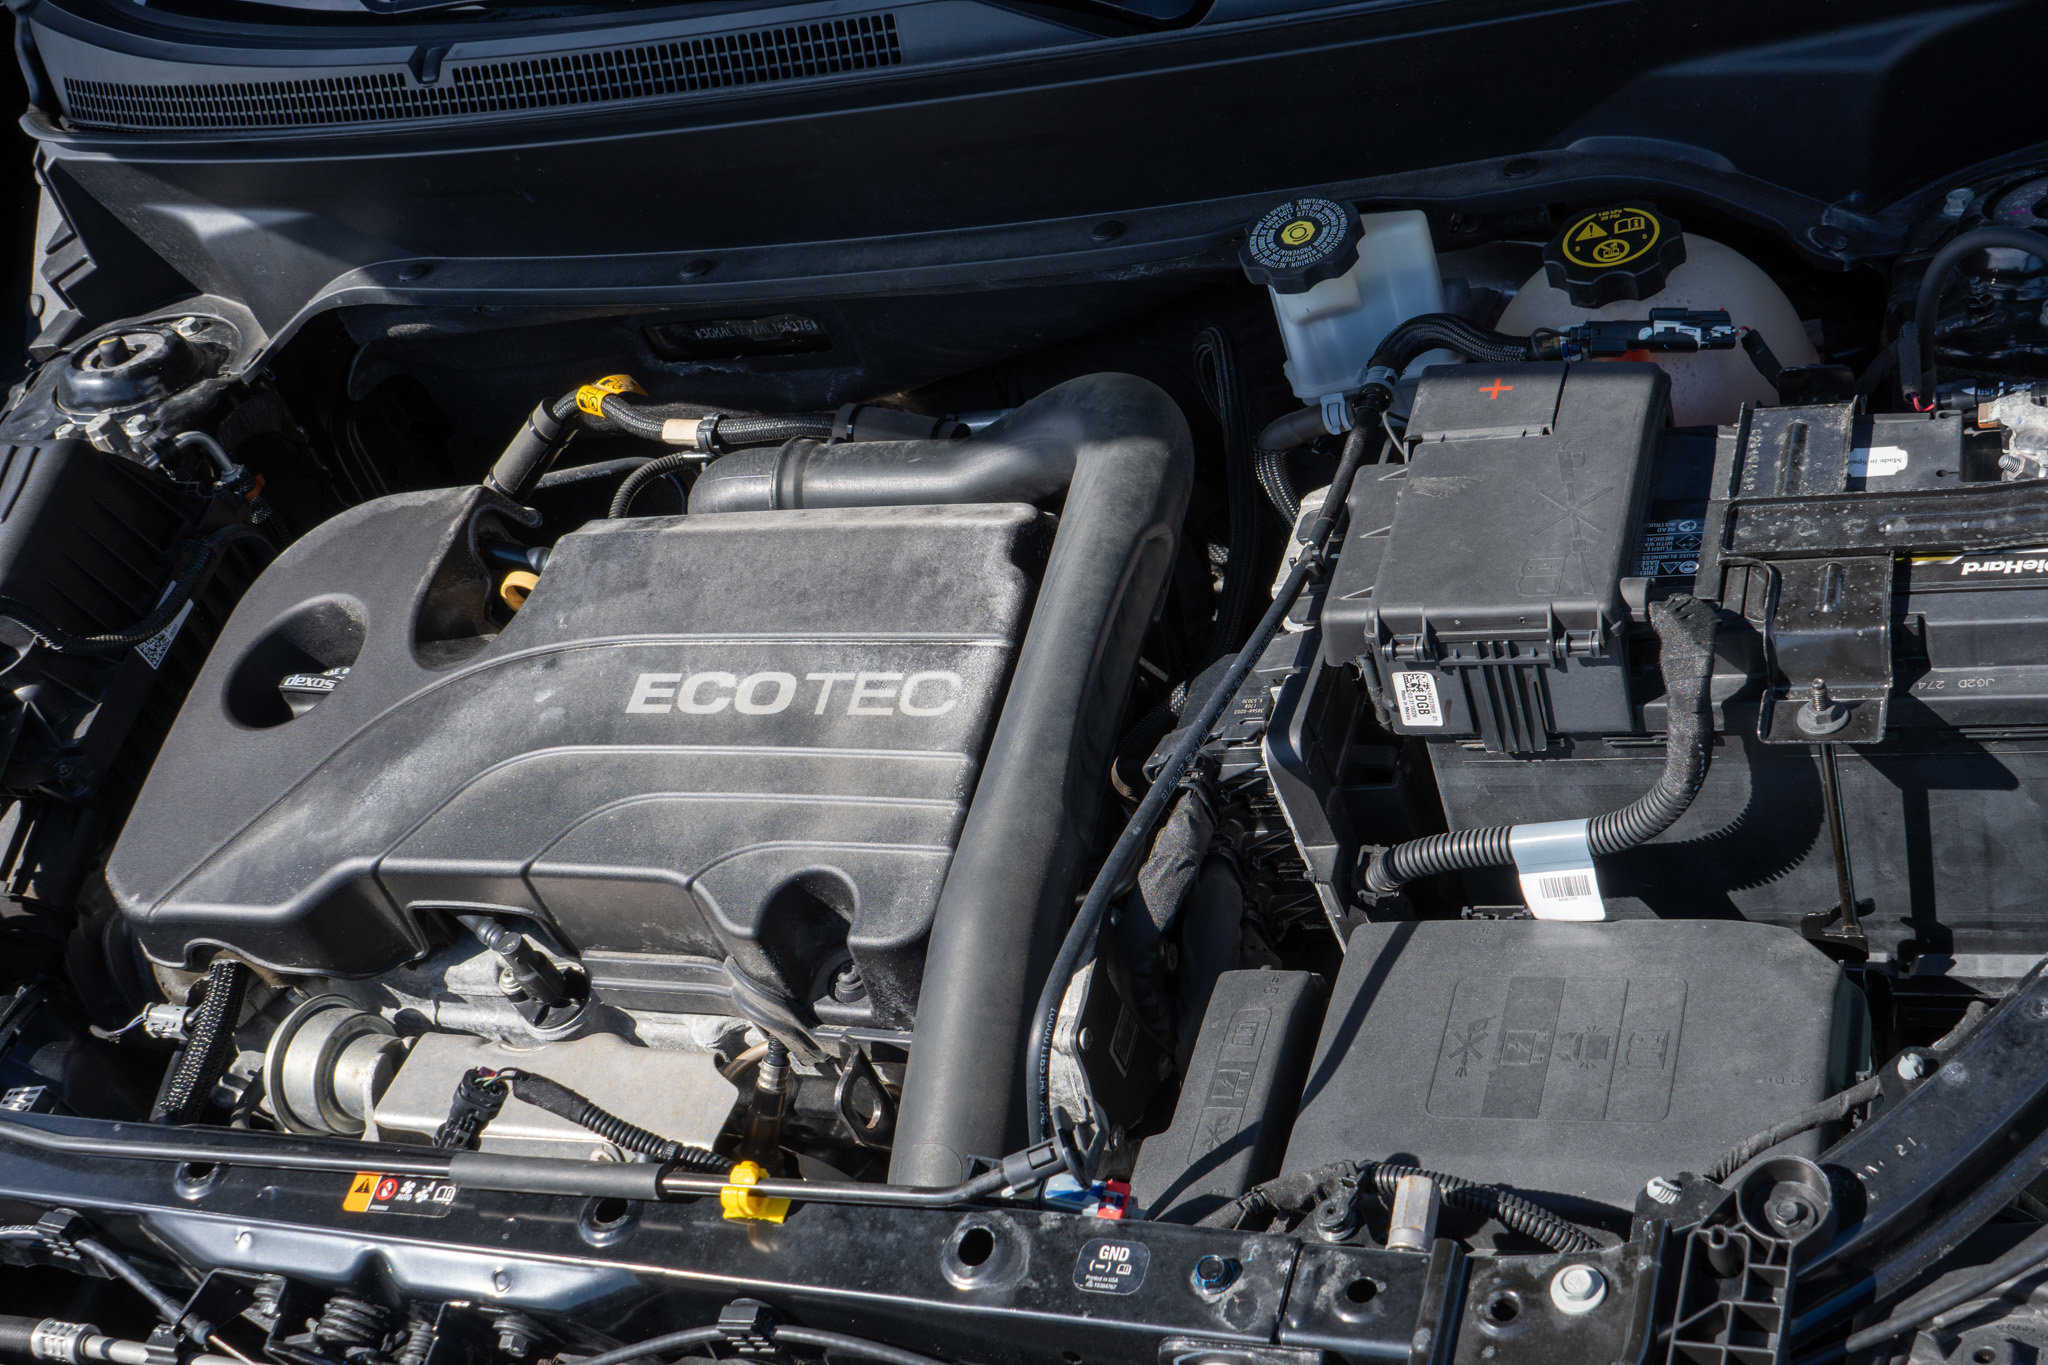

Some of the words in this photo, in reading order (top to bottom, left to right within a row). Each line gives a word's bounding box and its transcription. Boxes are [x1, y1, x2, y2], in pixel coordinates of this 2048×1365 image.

[1261, 214, 1272, 222] LA
[1263, 215, 1280, 228] FREIN
[1314, 213, 1329, 225] CLEAN
[1317, 241, 1331, 251] CAP
[1254, 253, 1264, 261] LE
[1267, 254, 1281, 262] QUE
[1259, 257, 1287, 269] NETTOYER
[283, 674, 339, 689] dexos
[1918, 680, 1945, 690] 274
[1958, 678, 1995, 688] JG2D
[625, 671, 964, 717] ECOTEC
[1415, 695, 1430, 715] DGB
[394, 1193, 413, 1201] AUTO
[1098, 1245, 1130, 1262] GND
